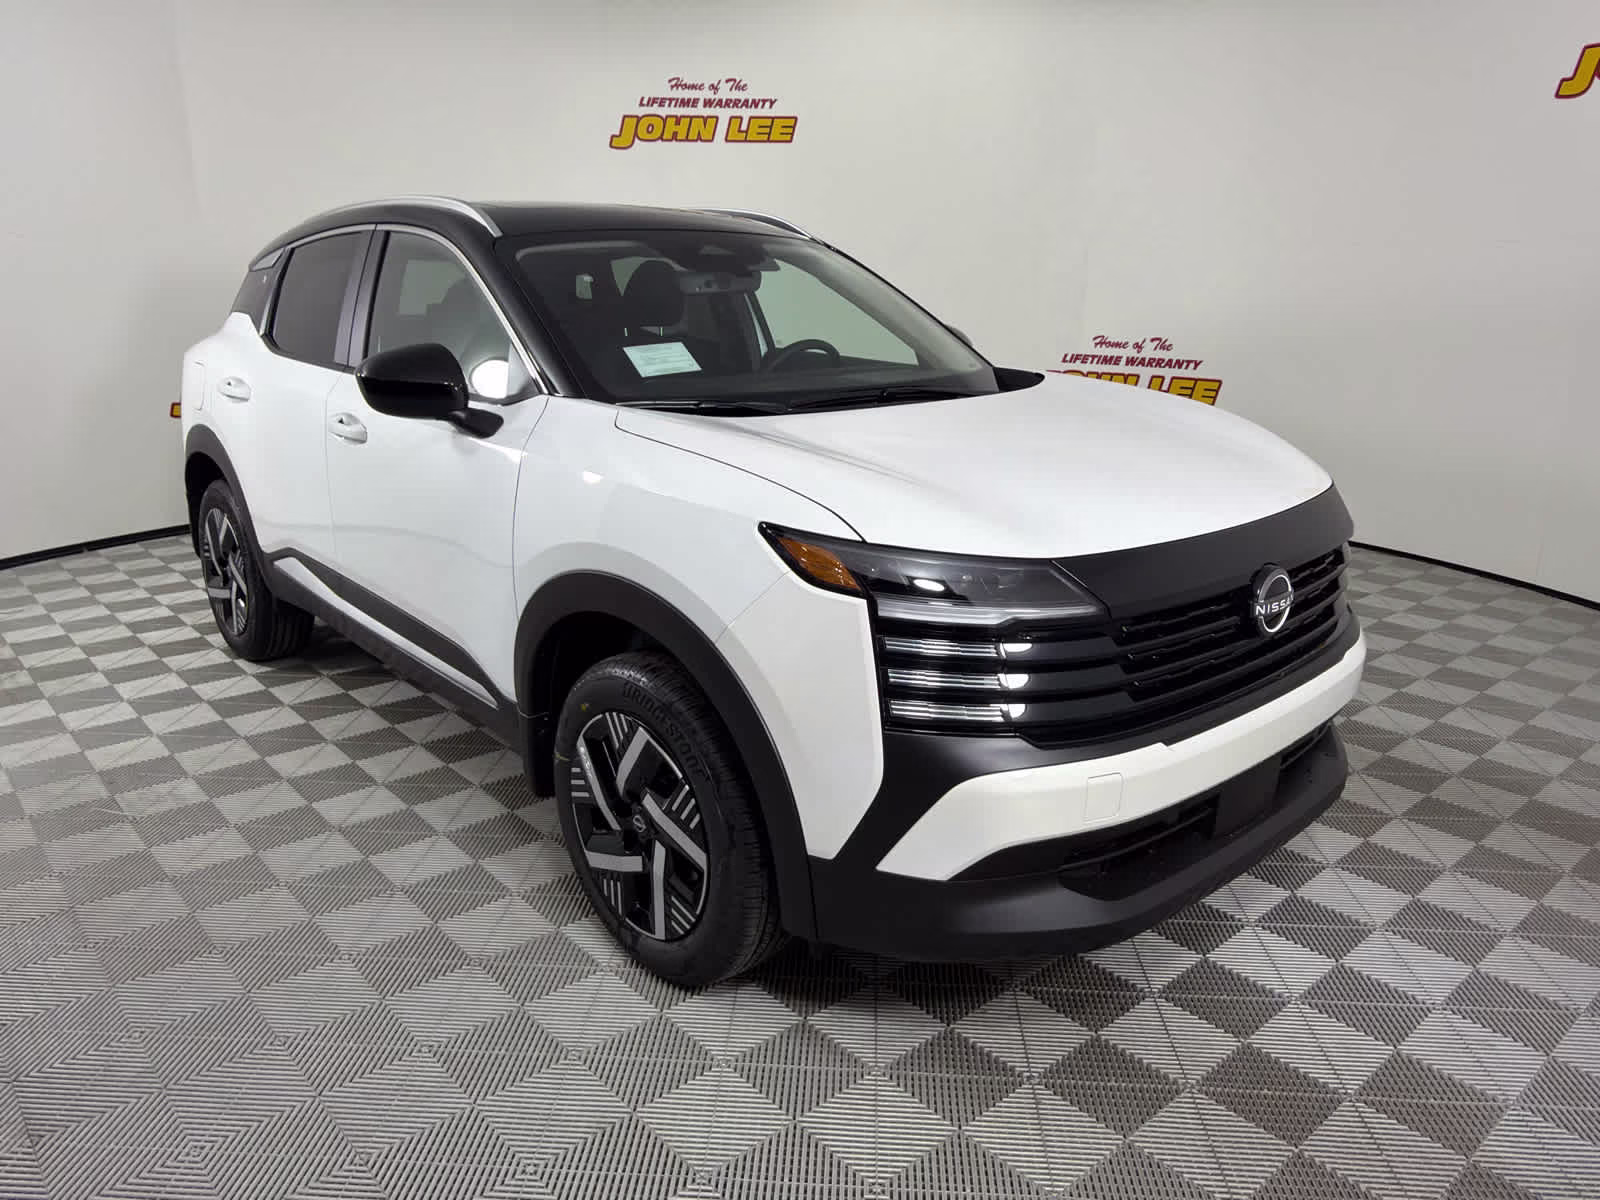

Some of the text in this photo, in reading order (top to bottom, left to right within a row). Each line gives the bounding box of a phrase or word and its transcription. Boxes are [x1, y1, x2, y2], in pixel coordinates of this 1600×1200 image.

[668, 77, 748, 94] Home of The
[638, 97, 777, 109] LIFETIME WARRANTY
[609, 114, 798, 150] JOHN LEE
[1093, 335, 1173, 354] Home of The
[1061, 353, 1203, 370] LIFETIME WARRANTY
